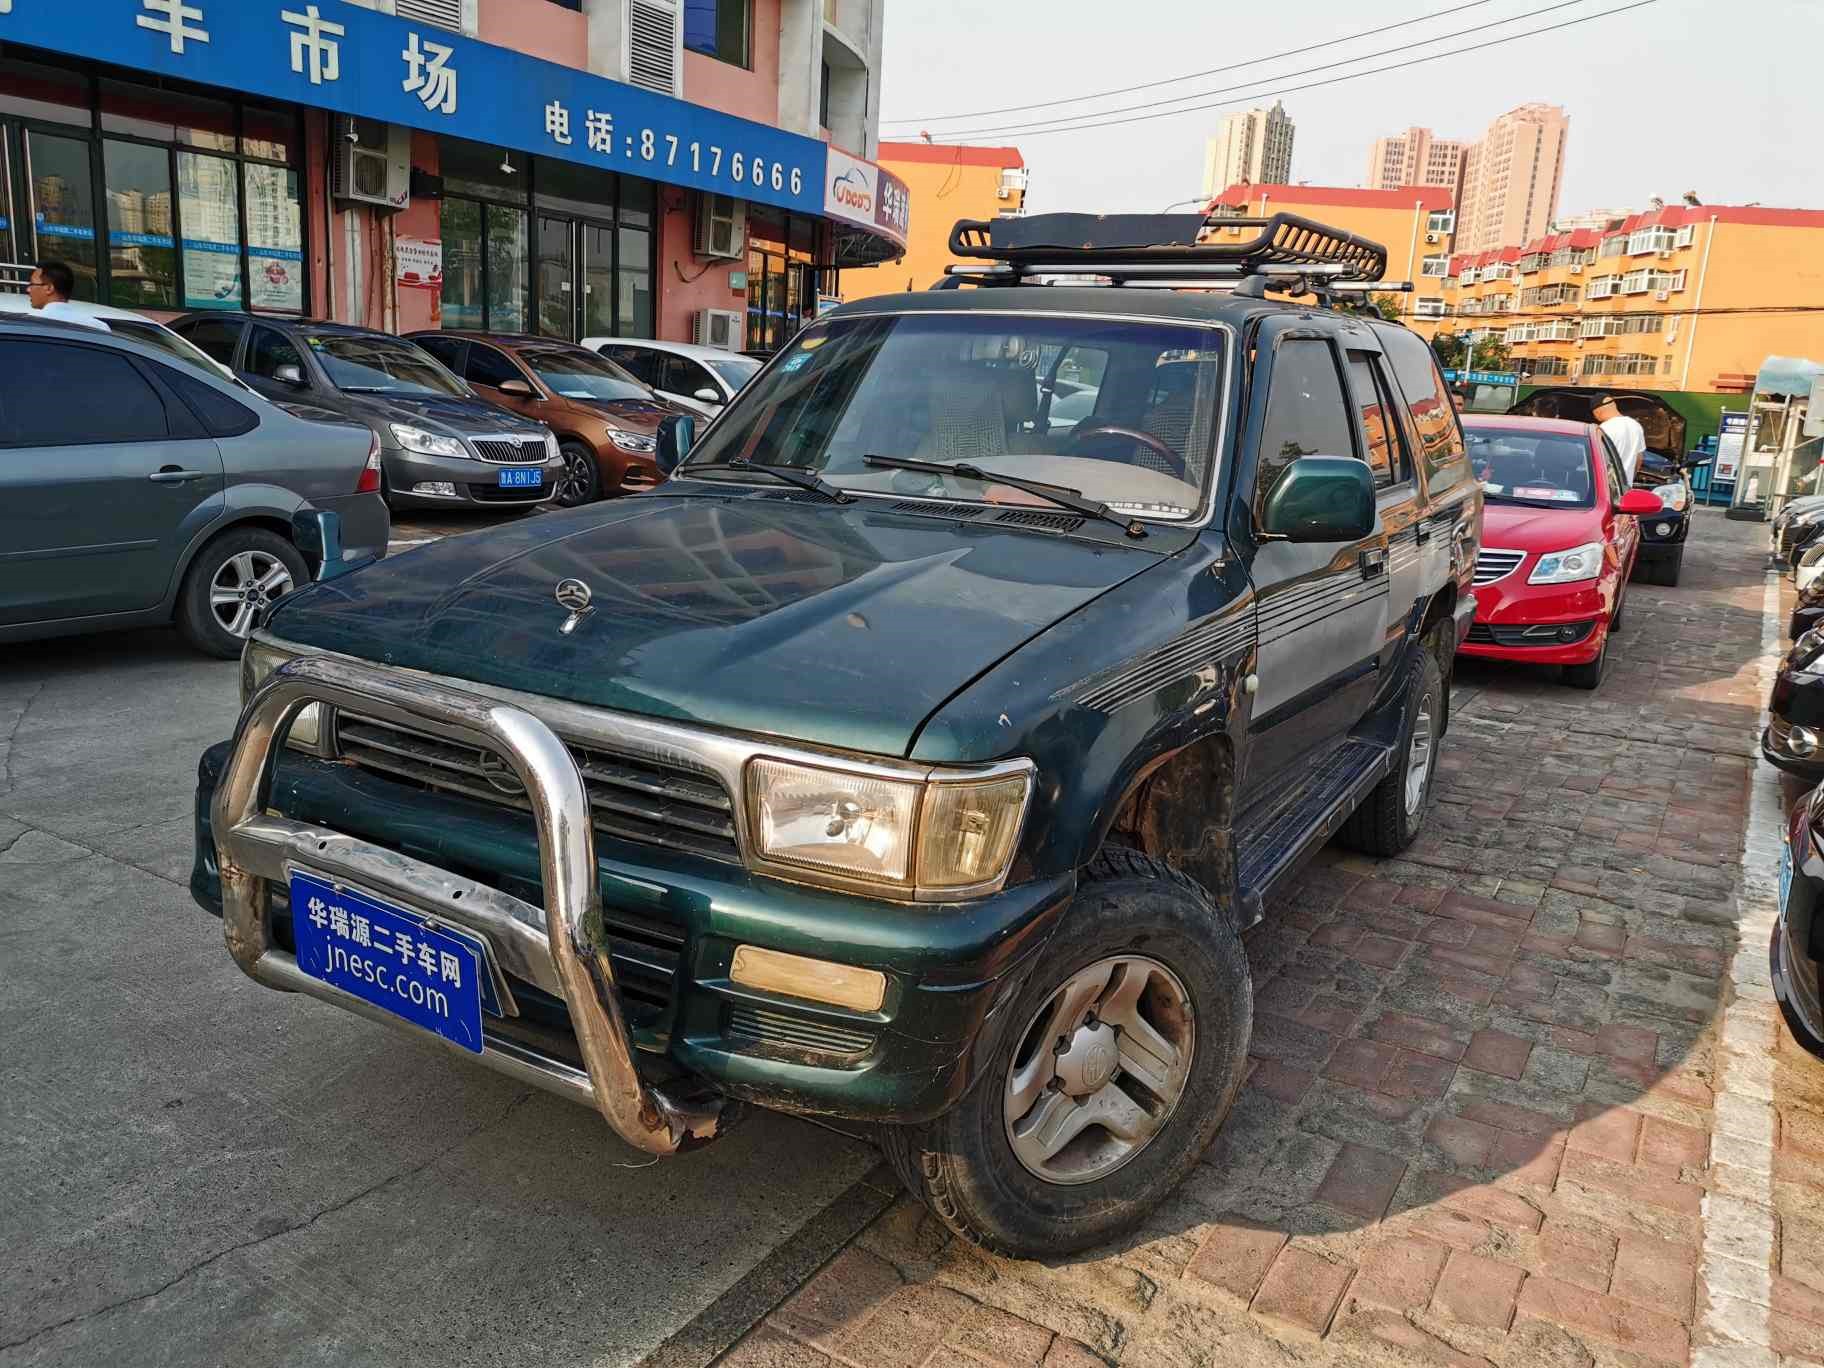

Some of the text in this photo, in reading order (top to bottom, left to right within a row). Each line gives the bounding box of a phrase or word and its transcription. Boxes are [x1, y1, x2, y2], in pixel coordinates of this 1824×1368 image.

[544, 100, 803, 196] 电话:87176666
[307, 895, 461, 989] 华瑞源二手车网
[324, 934, 450, 1019] jnesc.com
